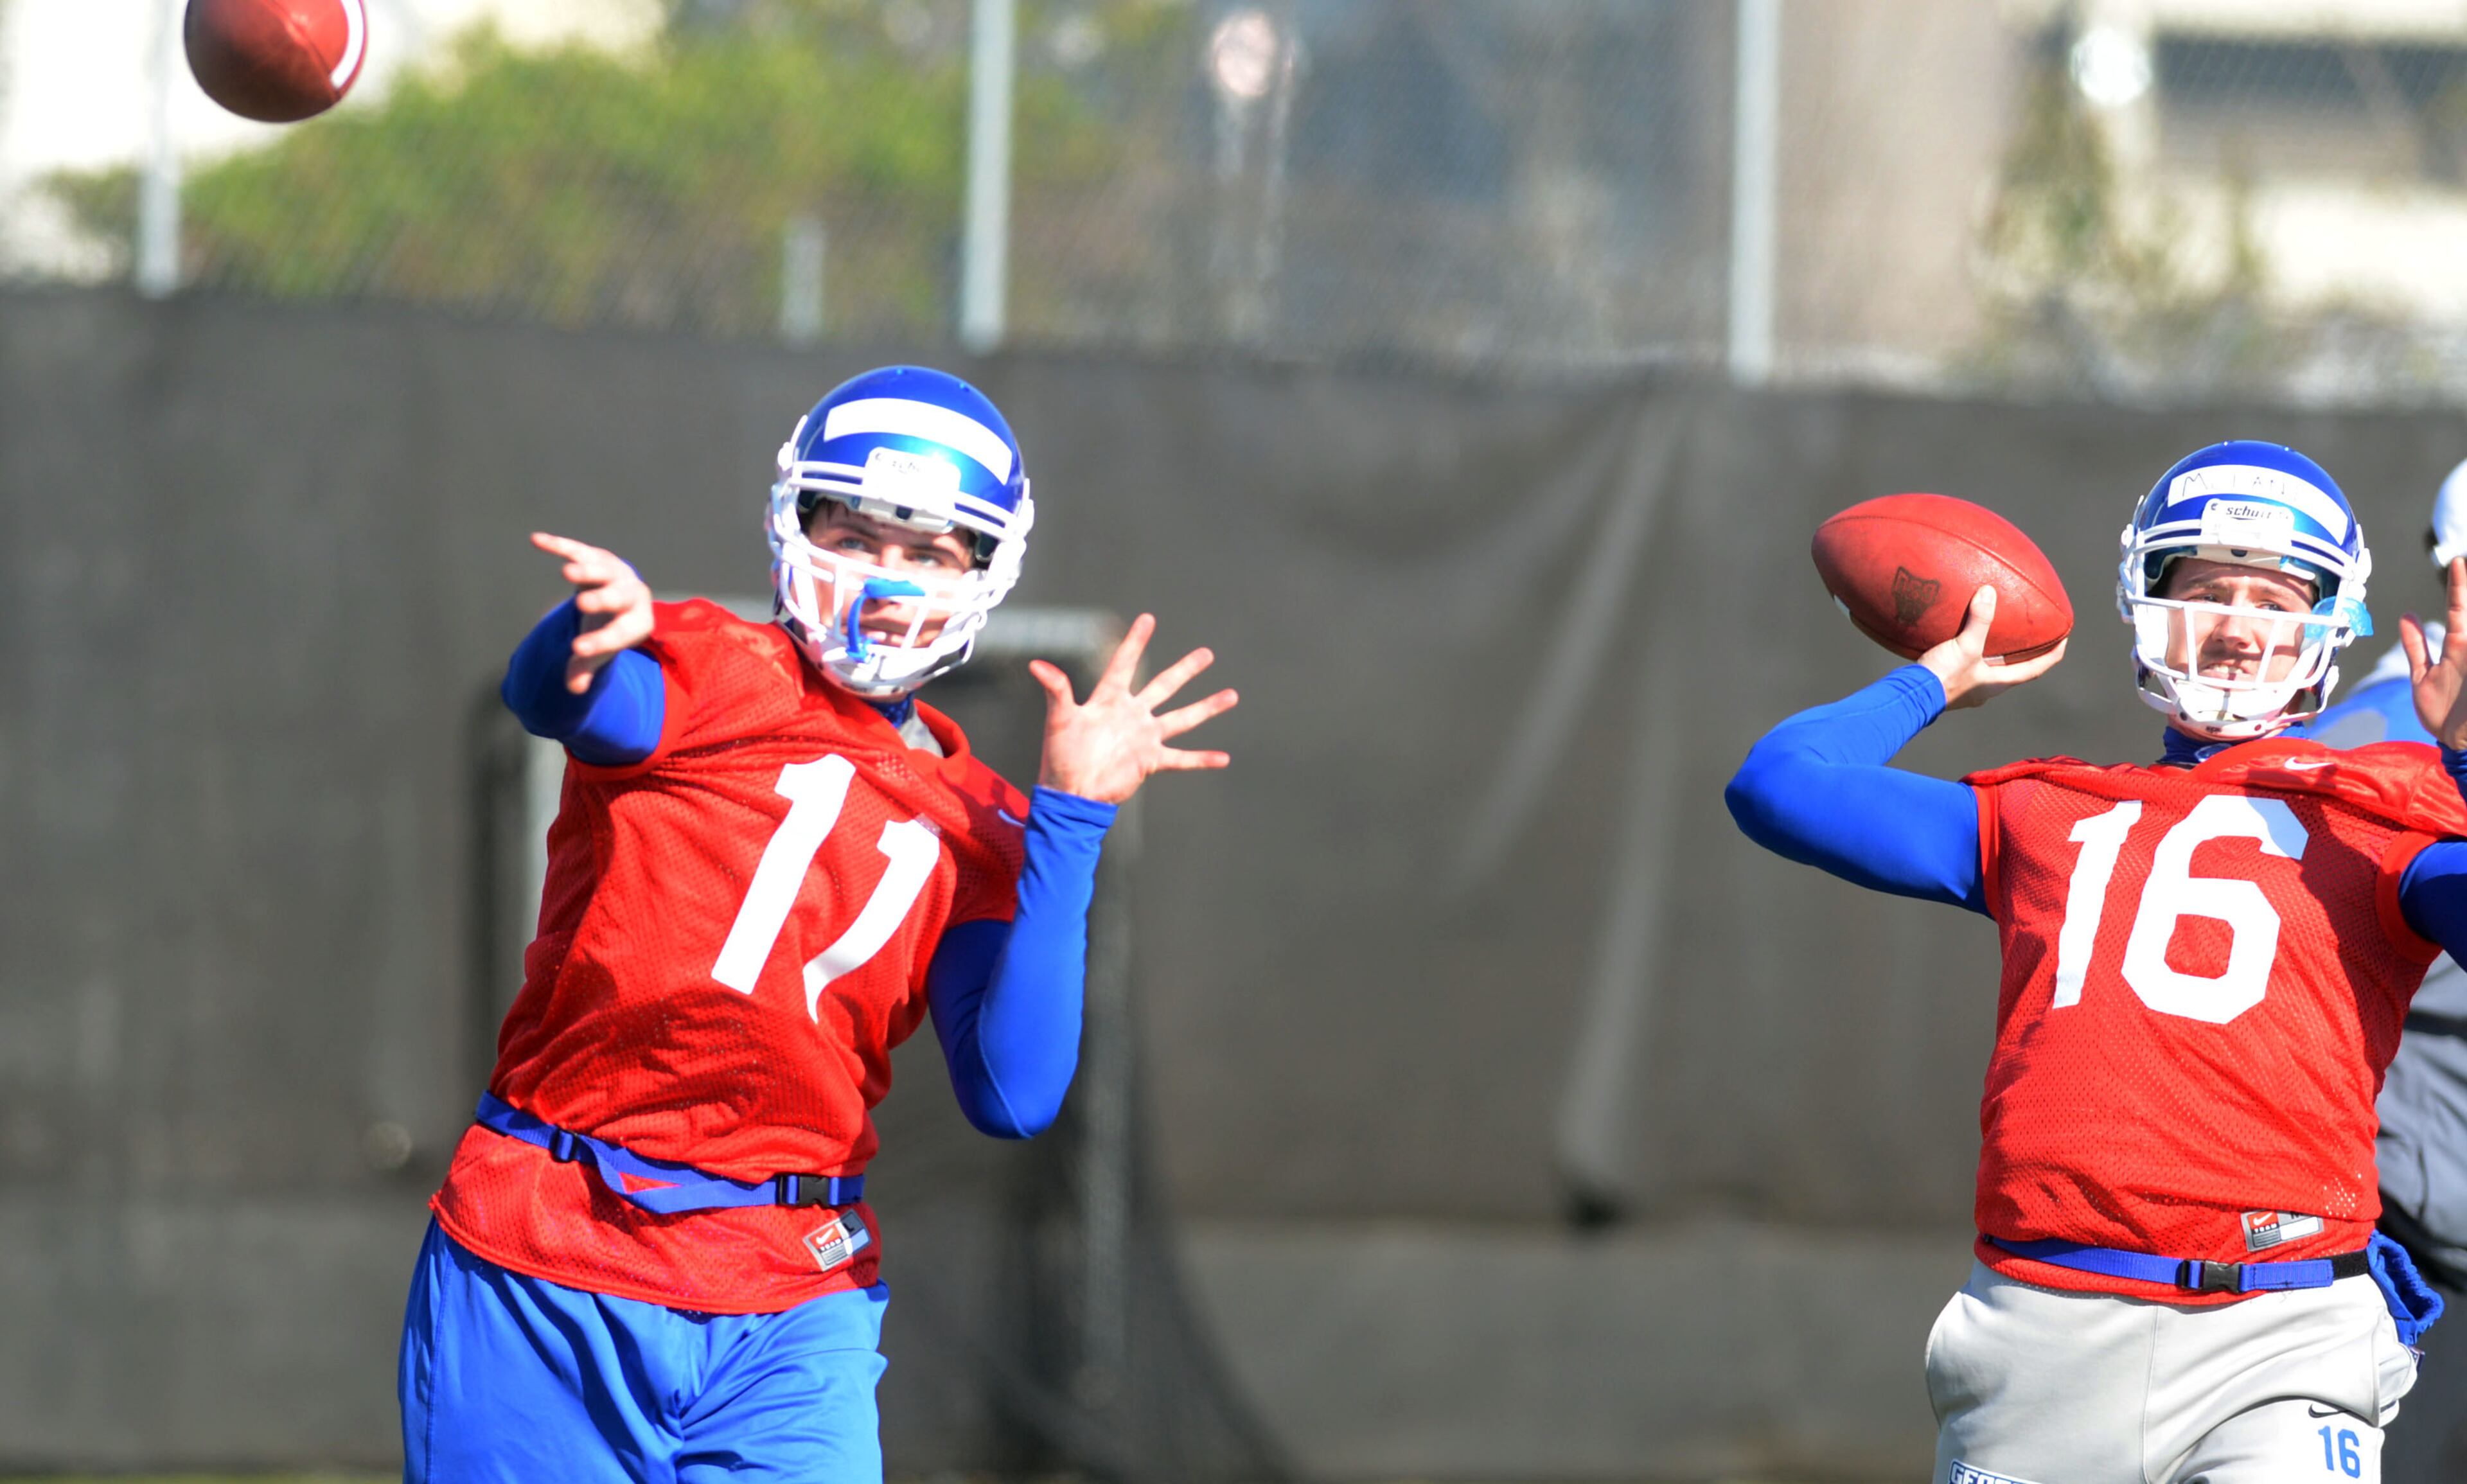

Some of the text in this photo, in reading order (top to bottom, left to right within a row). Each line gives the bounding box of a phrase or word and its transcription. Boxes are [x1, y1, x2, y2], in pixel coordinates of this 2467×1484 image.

[711, 754, 942, 1025] 11
[2053, 795, 2310, 1024] 16
[2318, 1426, 2361, 1479] 16
